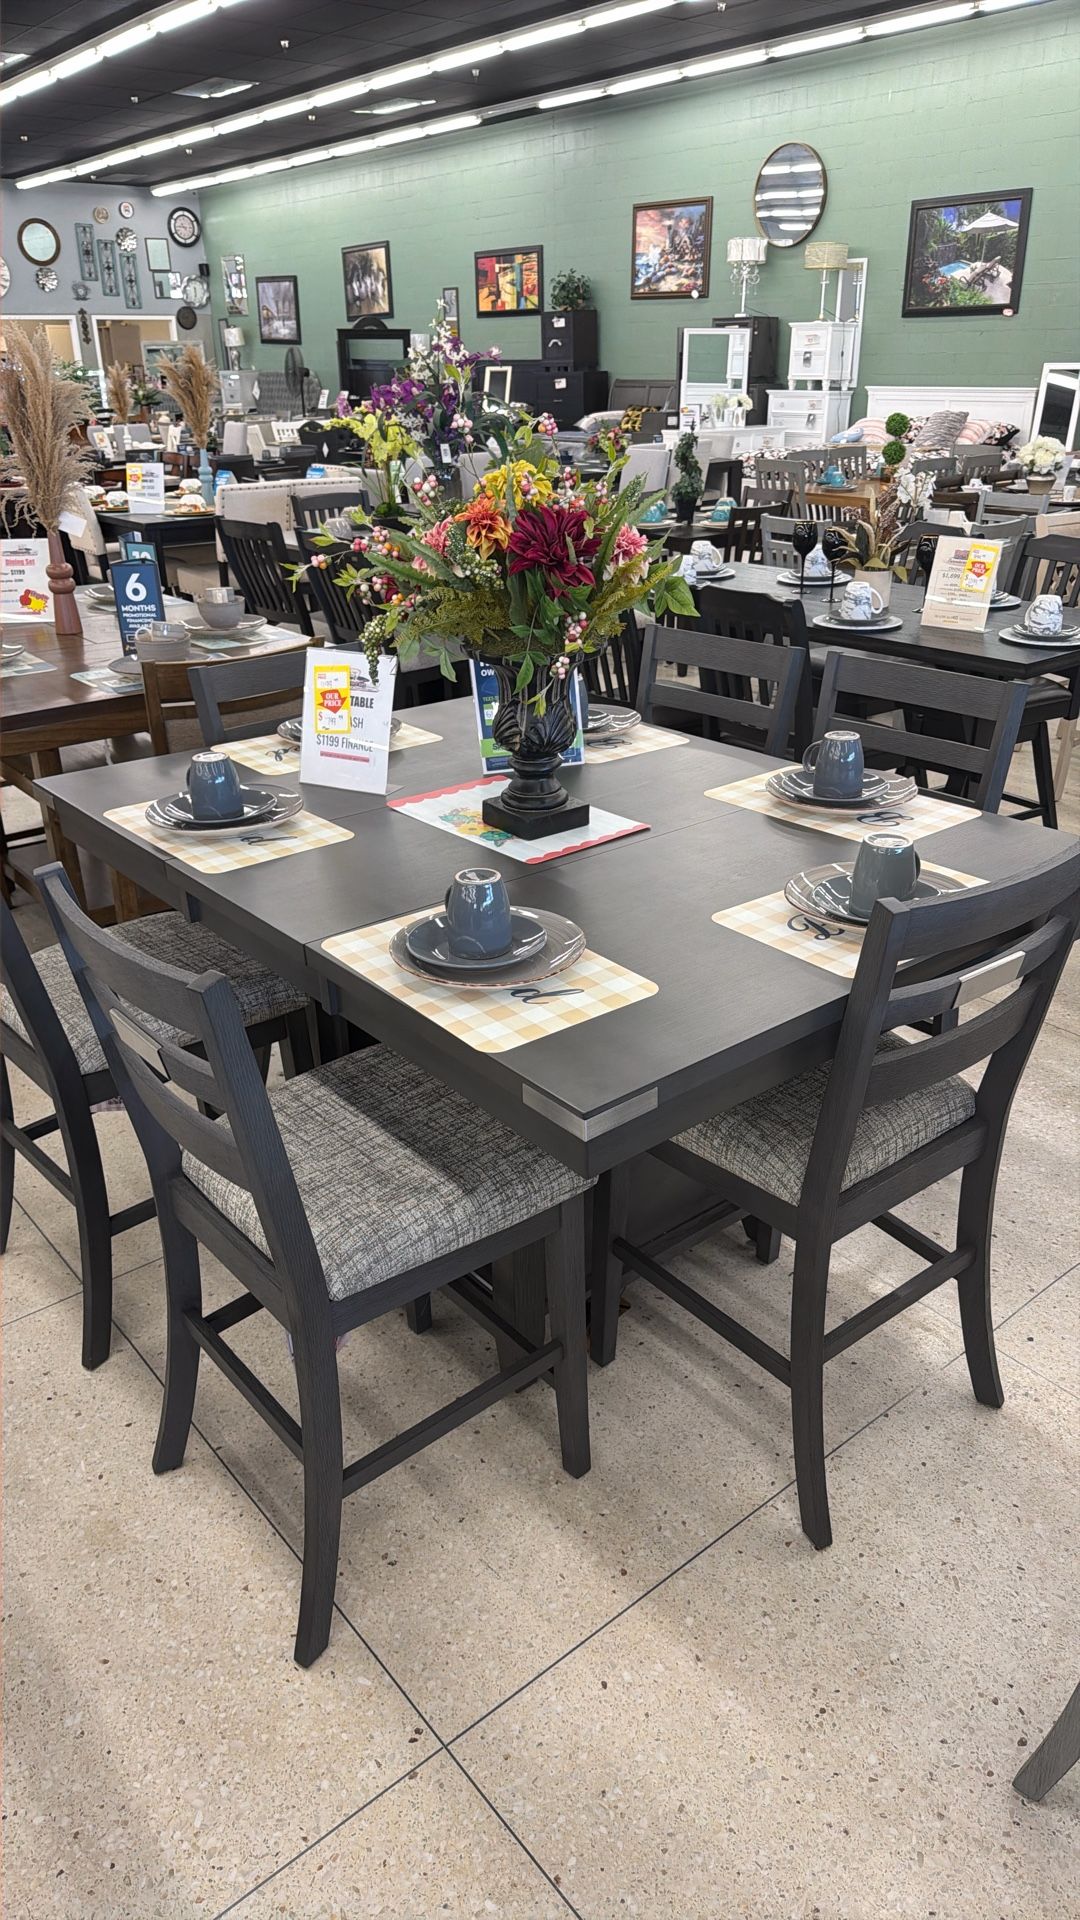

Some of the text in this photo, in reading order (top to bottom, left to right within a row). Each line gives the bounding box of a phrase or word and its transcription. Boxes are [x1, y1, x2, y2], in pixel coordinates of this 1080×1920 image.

[125, 572, 147, 602] 6
[121, 604, 157, 612] MONTHS
[325, 692, 339, 700] OUR
[350, 695, 375, 709] TABLE
[316, 733, 340, 748] $1199
